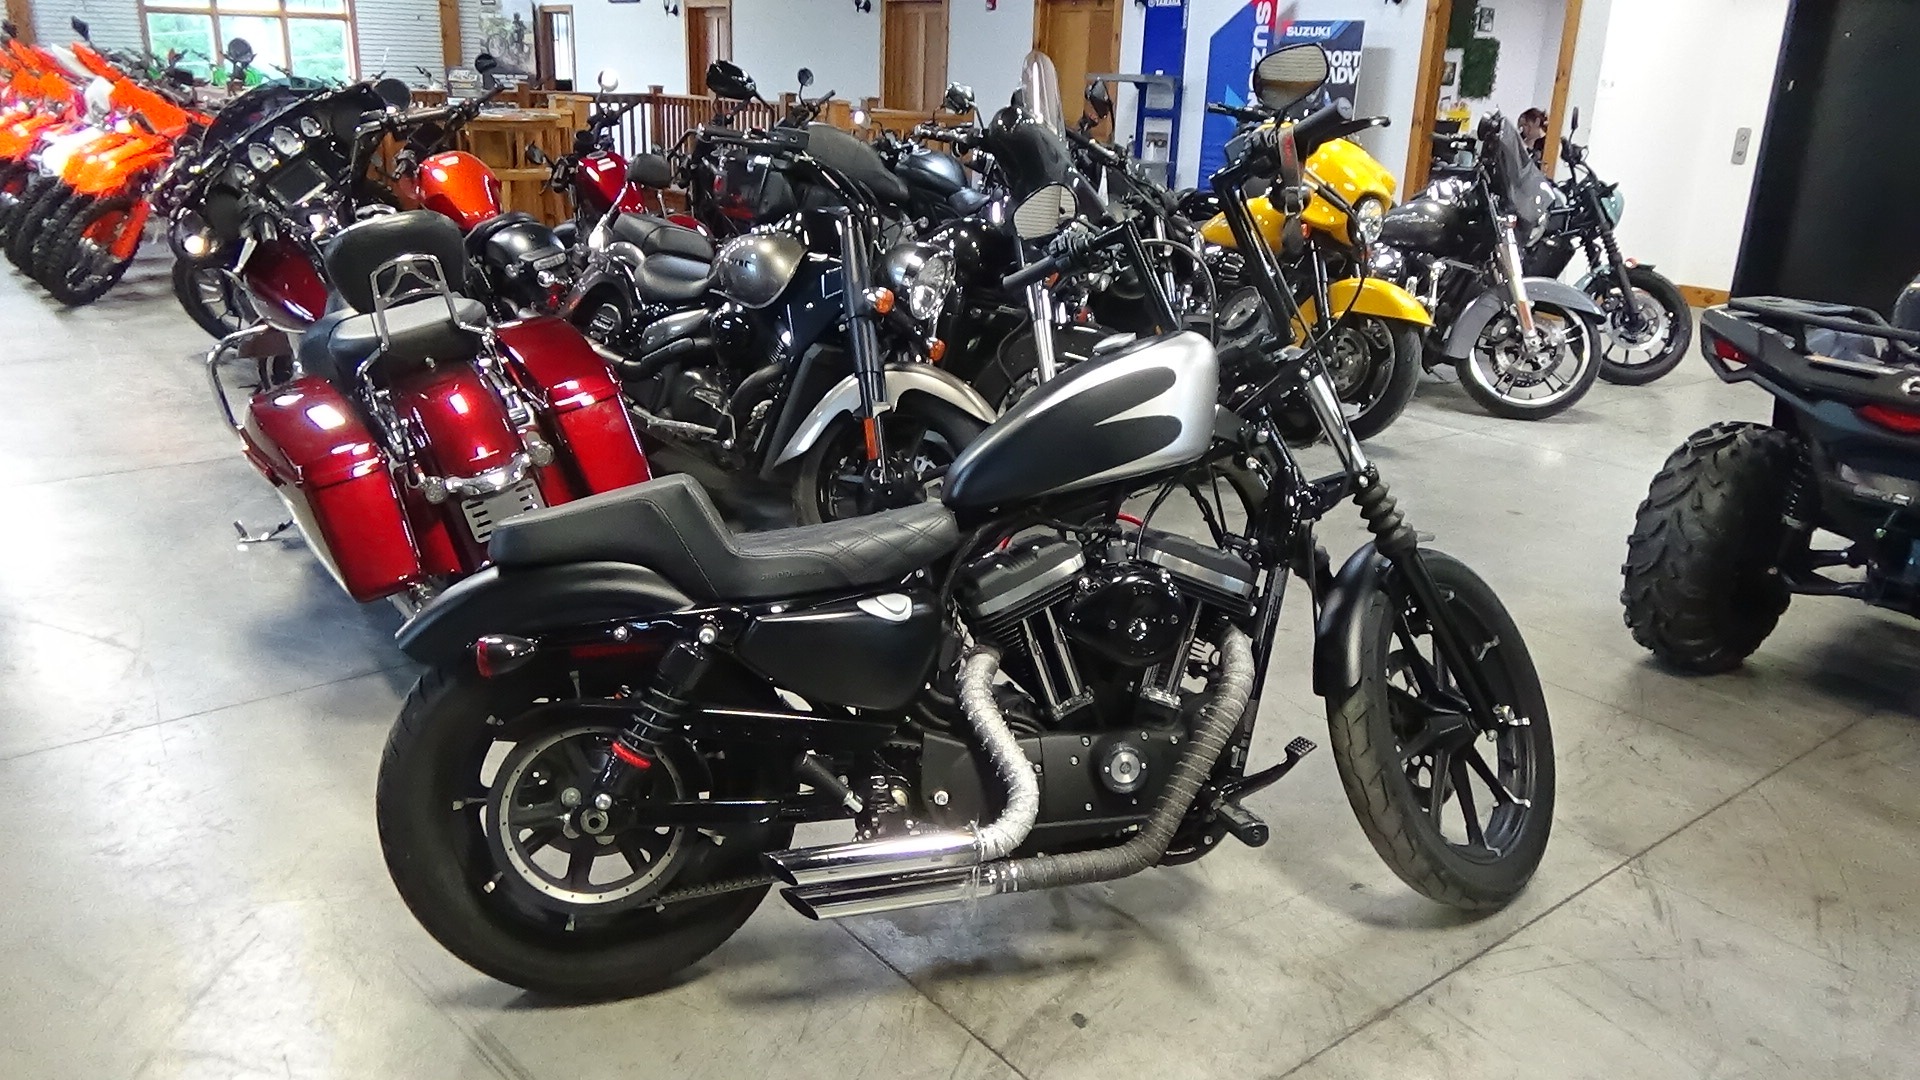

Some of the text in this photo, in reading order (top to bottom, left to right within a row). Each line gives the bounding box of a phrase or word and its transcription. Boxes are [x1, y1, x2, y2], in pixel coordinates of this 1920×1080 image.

[1286, 26, 1331, 37] SUZUKI
[1245, 1, 1272, 108] SUZK
[1324, 66, 1360, 84] ADV
